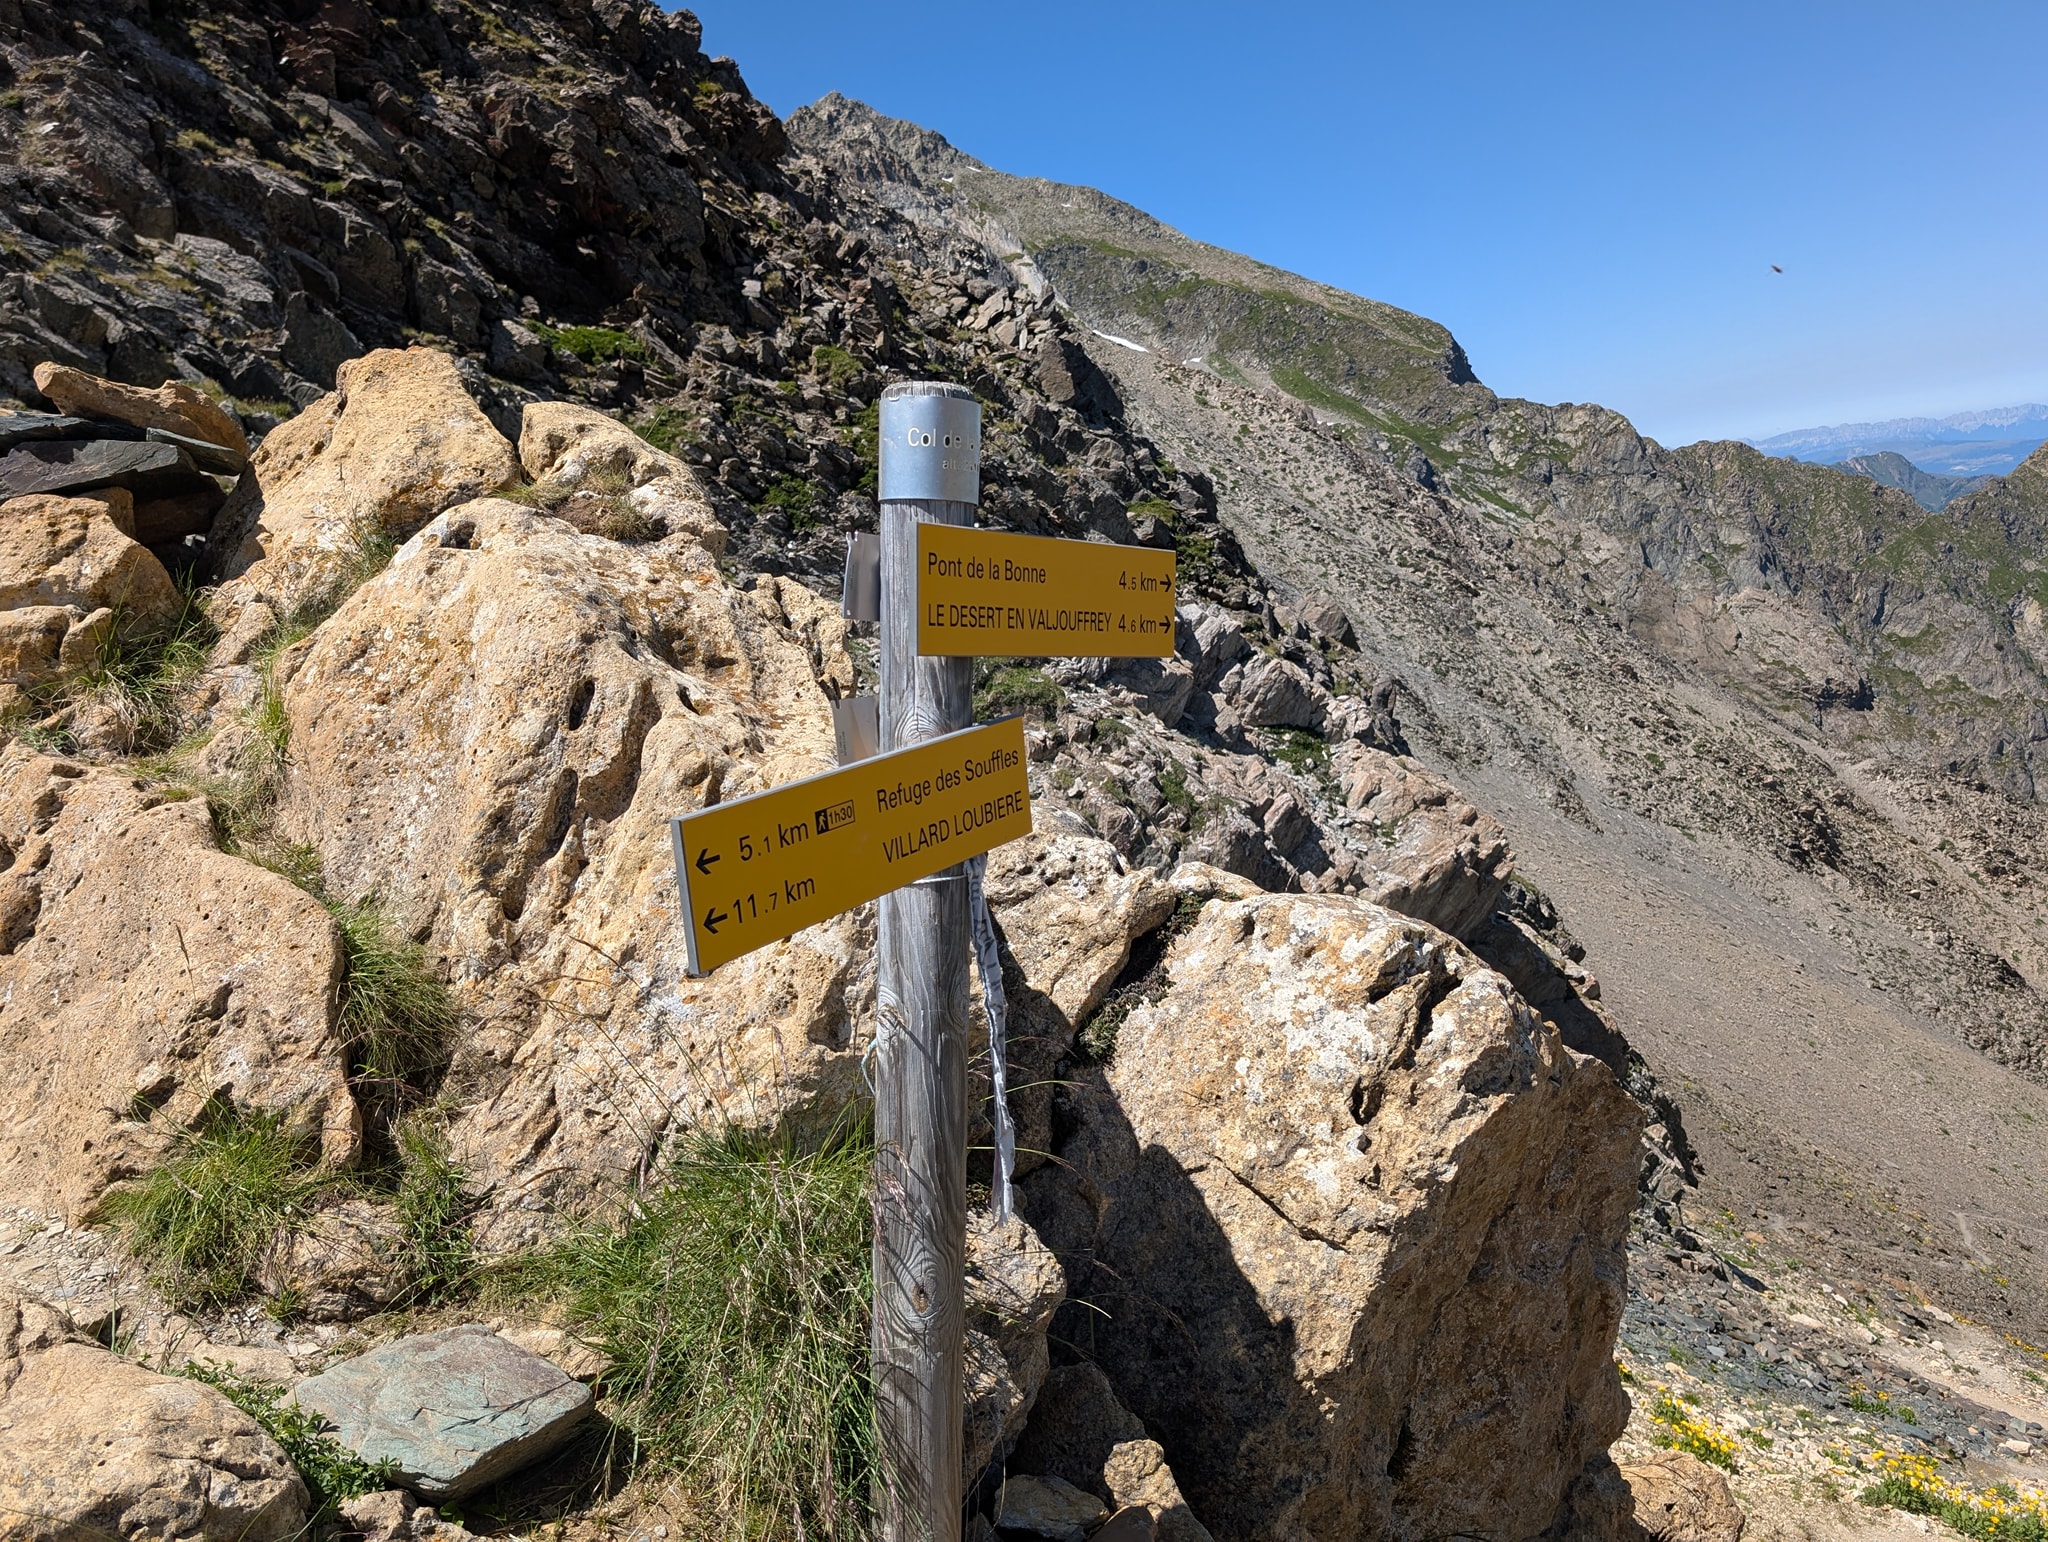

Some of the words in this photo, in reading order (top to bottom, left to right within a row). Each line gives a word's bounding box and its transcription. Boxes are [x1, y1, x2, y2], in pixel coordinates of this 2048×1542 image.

[908, 427, 936, 447] Col
[943, 430, 962, 448] de
[928, 552, 962, 577] Pont
[967, 556, 984, 579] de
[989, 558, 1000, 580] la
[1005, 560, 1046, 584] Bonne
[1119, 571, 1137, 591] 4.5
[1140, 572, 1157, 592] km
[928, 603, 945, 627] LE
[950, 605, 1003, 629] DESERT
[1007, 607, 1025, 630] EN
[1028, 608, 1112, 632] VALJOUFFREY
[1118, 614, 1136, 633] 4.6
[1140, 615, 1157, 634] km
[739, 835, 771, 862] 5.1
[778, 822, 809, 848] km
[828, 805, 853, 825] 1h30
[876, 780, 931, 813] Refuge
[936, 769, 961, 792] des
[964, 749, 1019, 781] Souffles
[733, 893, 778, 924] 11.7
[784, 877, 816, 904] km
[882, 819, 950, 863] VILLARD
[954, 790, 1023, 836] LOUBIERE
